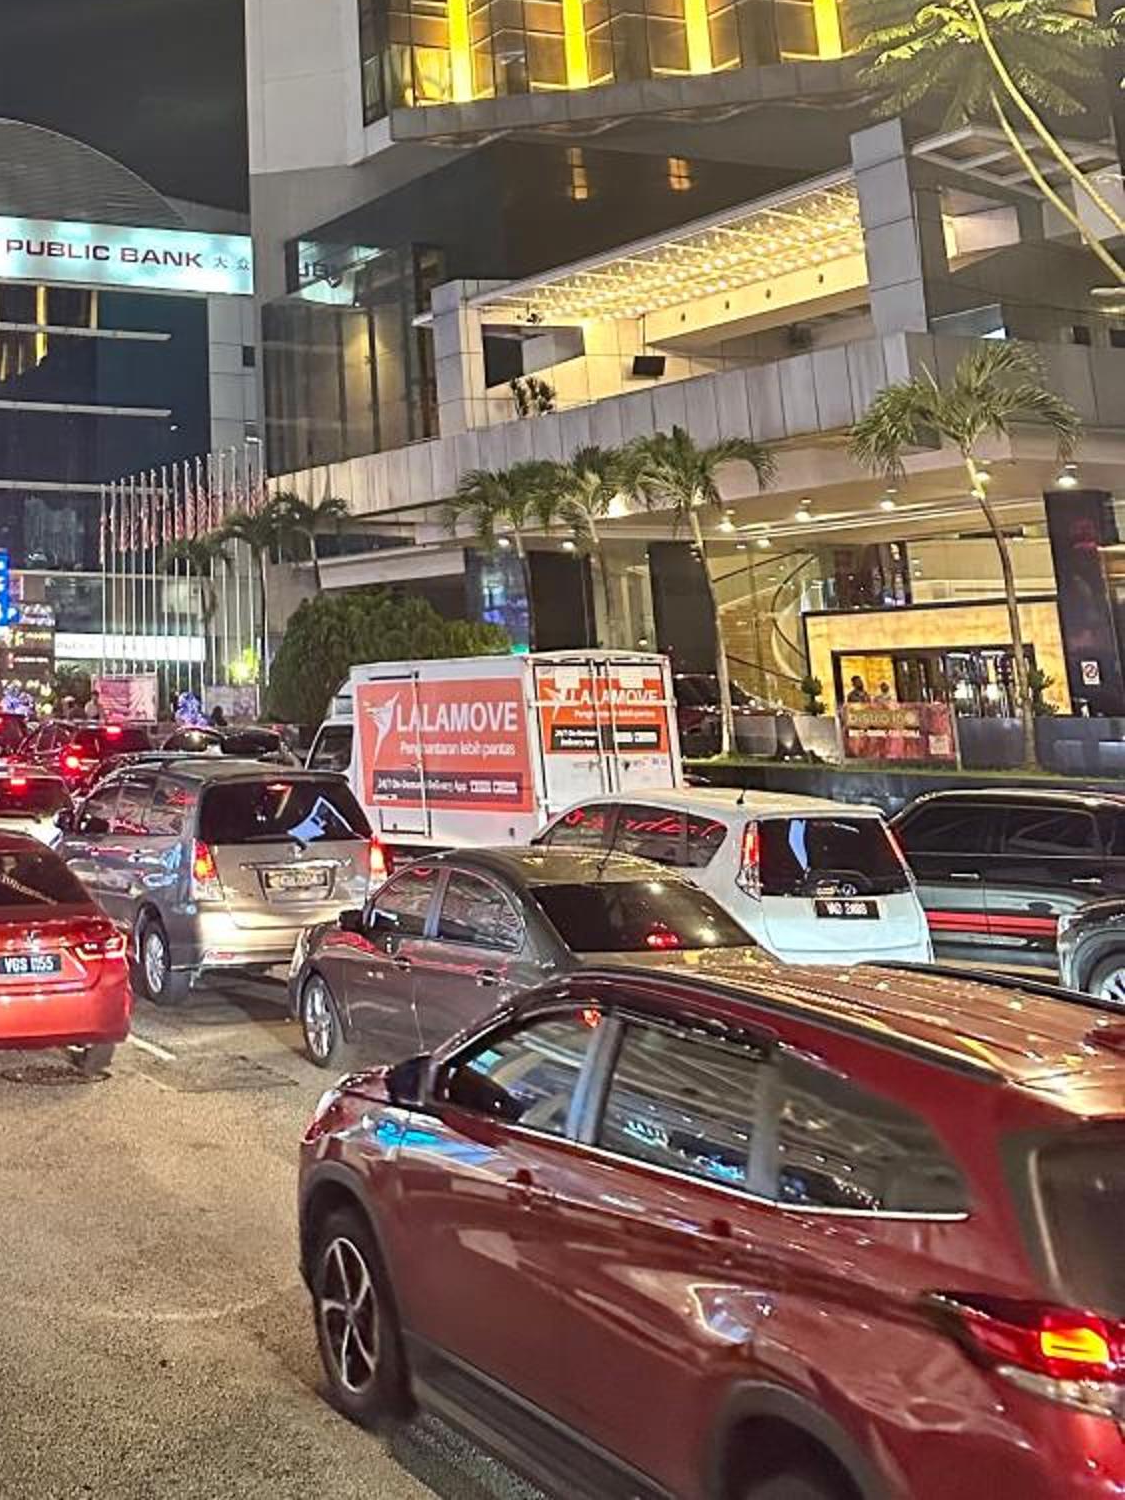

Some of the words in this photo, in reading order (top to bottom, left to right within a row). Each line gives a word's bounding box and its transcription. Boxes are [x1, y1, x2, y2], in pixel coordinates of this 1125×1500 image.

[6, 238, 111, 262] PUBLIC
[120, 247, 204, 269] BANK
[396, 701, 519, 733] LALAMOVE
[4, 957, 28, 973] VGS
